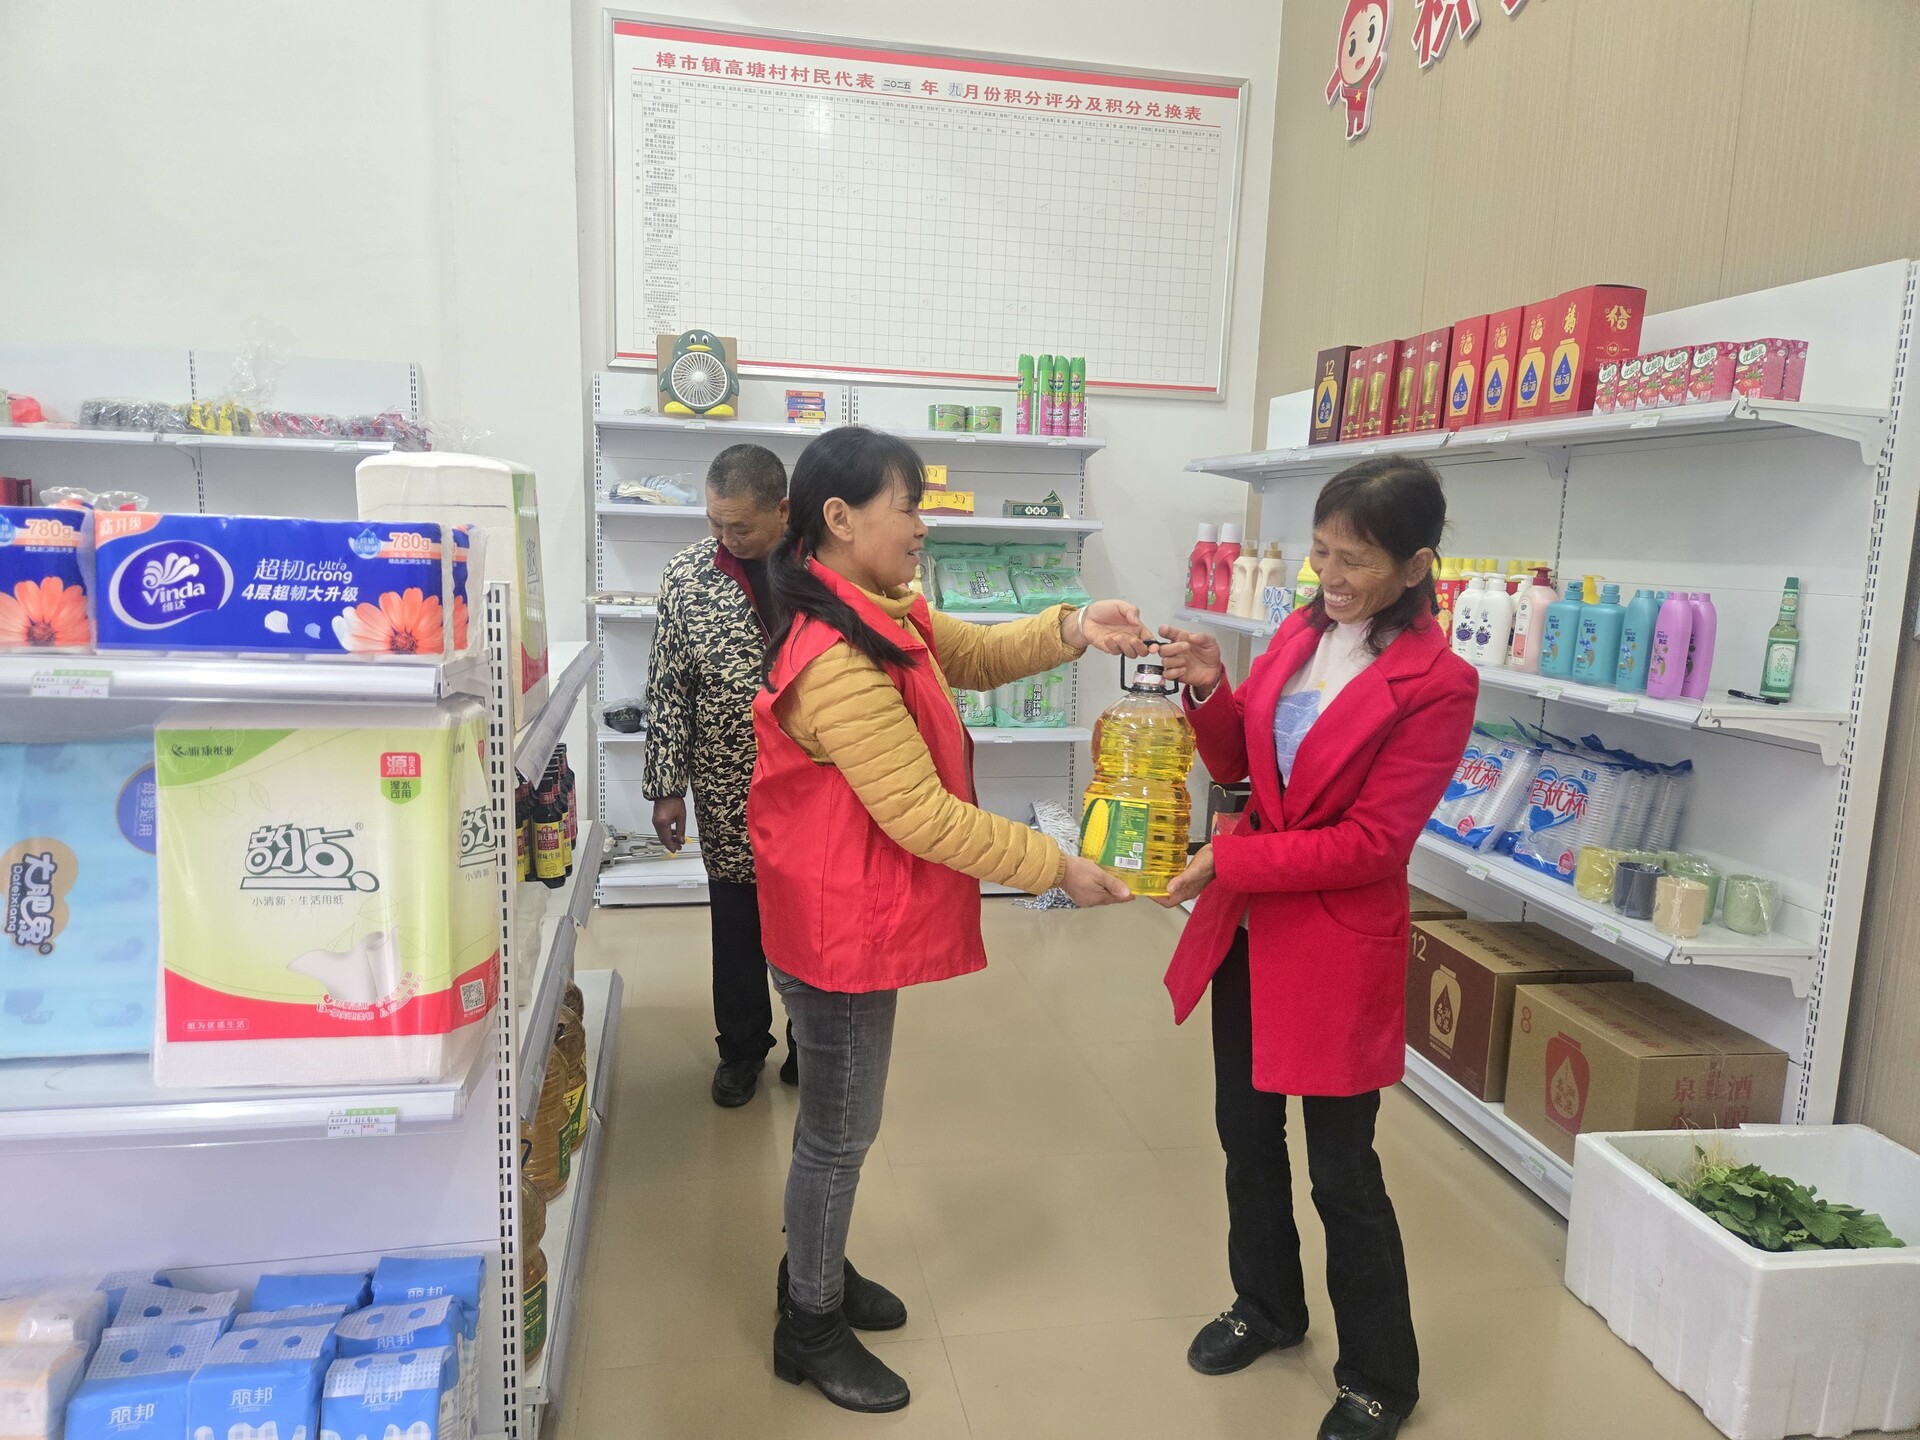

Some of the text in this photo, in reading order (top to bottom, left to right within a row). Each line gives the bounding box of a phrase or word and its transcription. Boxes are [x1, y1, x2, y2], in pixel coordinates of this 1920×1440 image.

[656, 51, 875, 89] 樟市镇高塘村村民代表
[921, 79, 939, 96] 年
[949, 81, 962, 97] 九
[963, 84, 1203, 121] 月份积分评分及积分兑换表
[1324, 359, 1335, 377] 12
[27, 519, 72, 539] 780g
[99, 516, 142, 537] 新升级
[388, 532, 431, 551] 780g
[253, 558, 300, 581] 超韧
[305, 565, 353, 584] Strong
[319, 558, 348, 571] Ultra
[142, 581, 206, 606] Vinda
[241, 583, 359, 602] 4层超韧大升级
[162, 600, 187, 613] 维达
[386, 755, 408, 776] 源
[390, 789, 412, 799] 可用
[1528, 778, 1590, 820] 百优杯
[139, 782, 156, 837] 母婴适用
[1411, 930, 1428, 962] 12
[1520, 1006, 1532, 1034] 8
[231, 1387, 273, 1406] 丽邦
[362, 1390, 404, 1406] 丽邦
[108, 1403, 155, 1425] 丽邦
